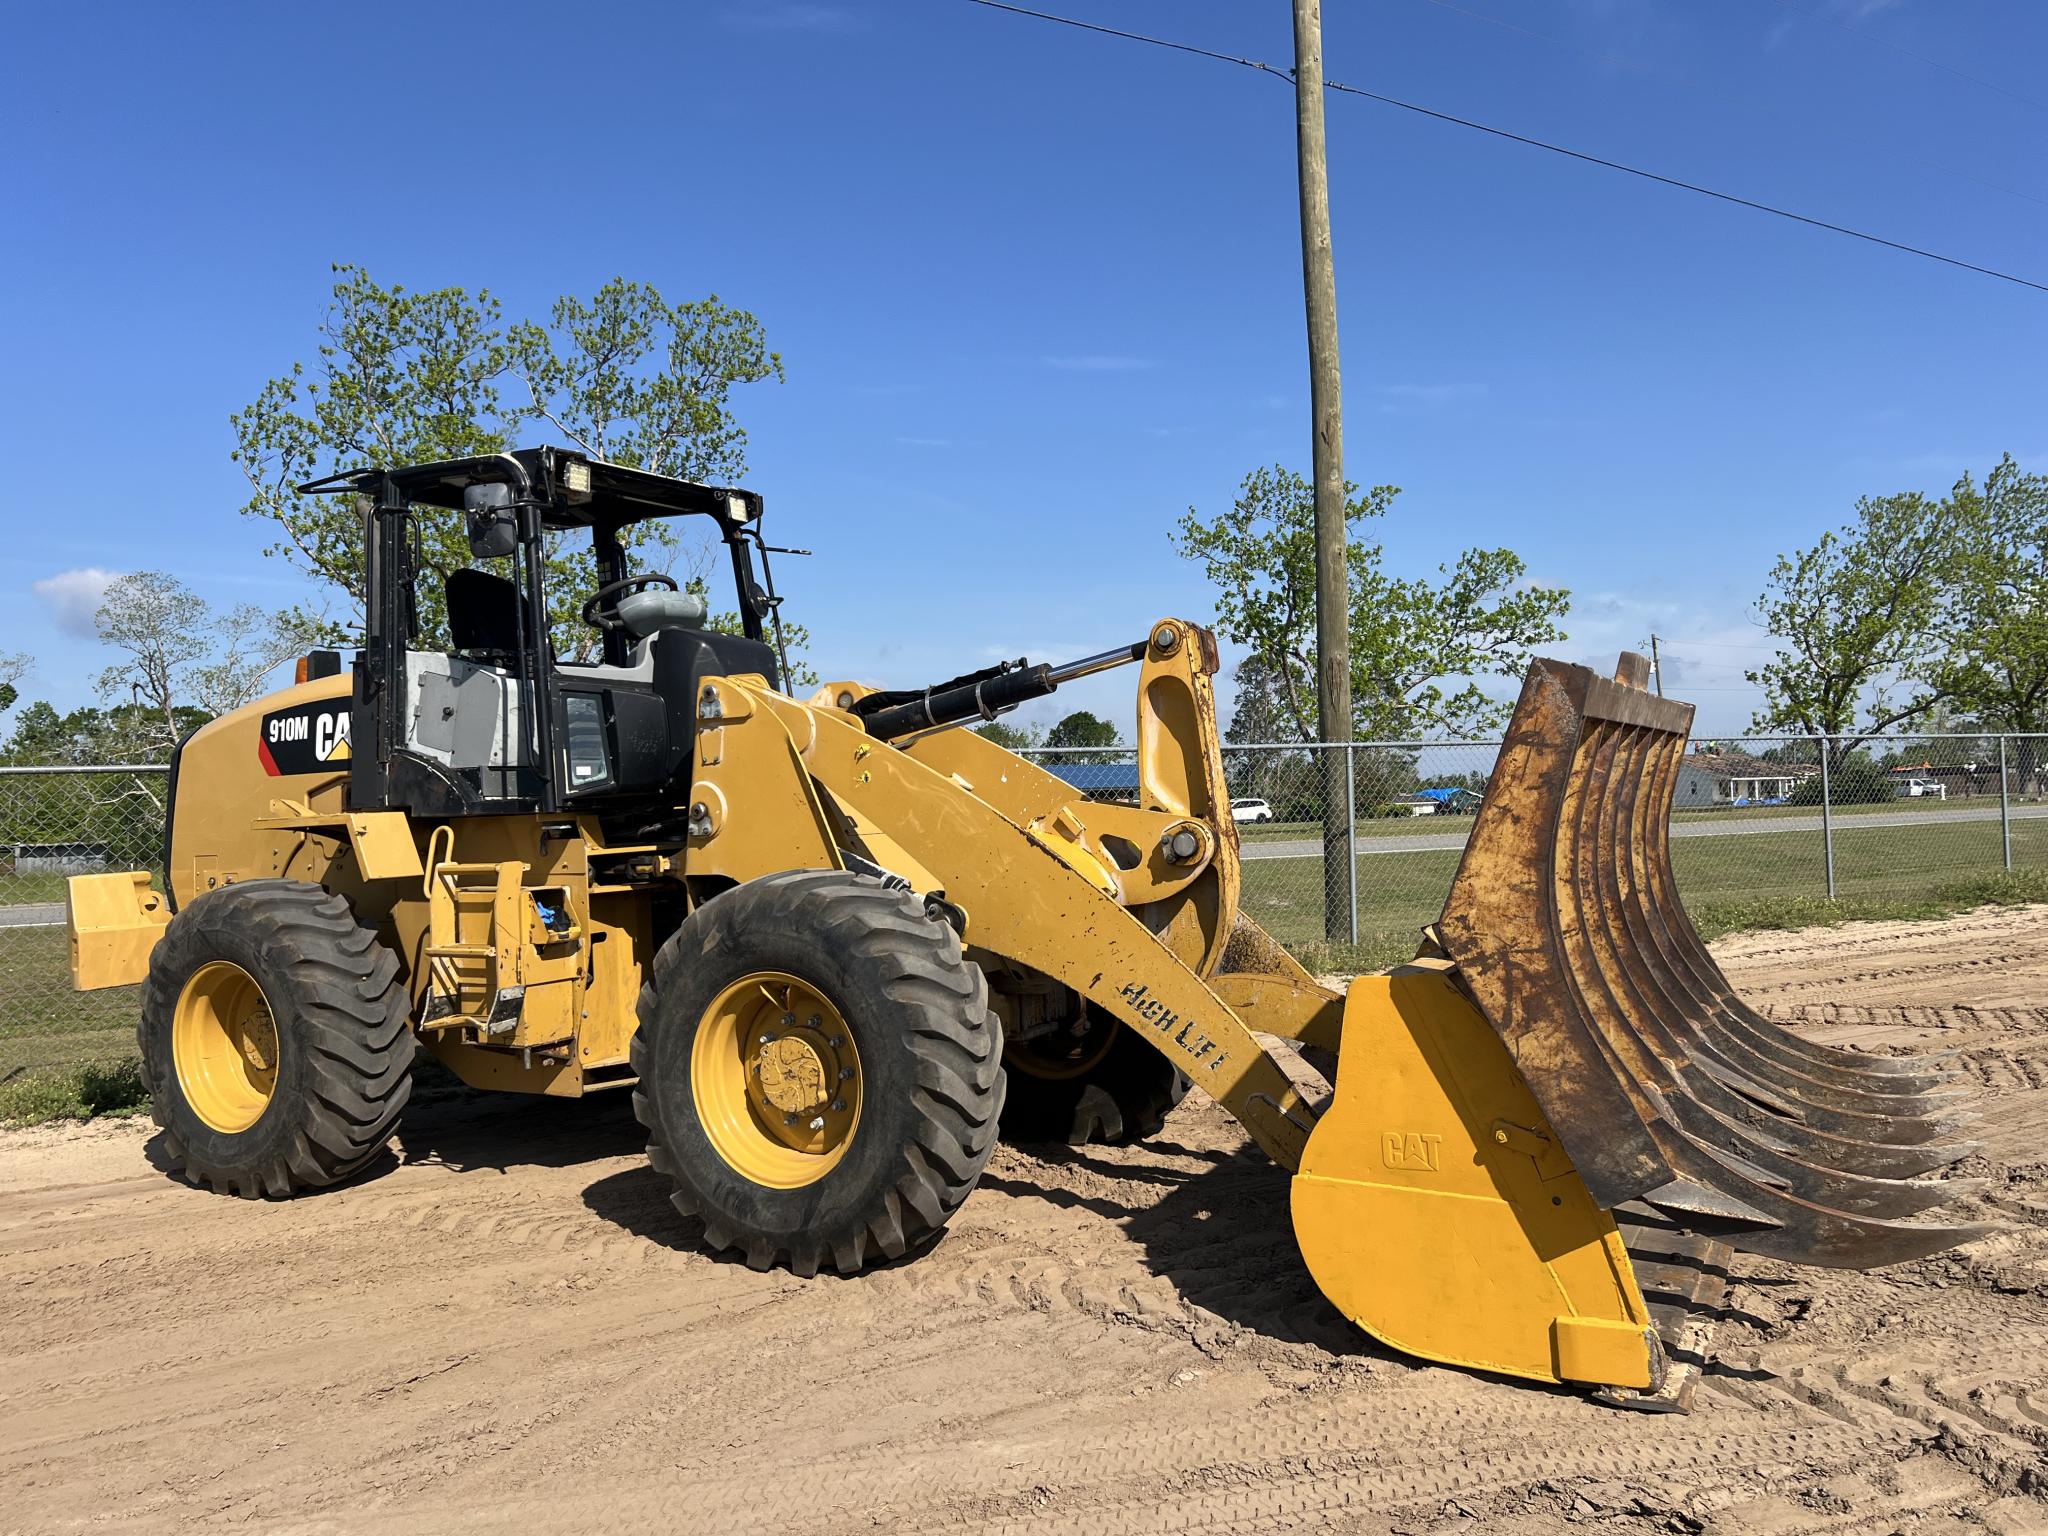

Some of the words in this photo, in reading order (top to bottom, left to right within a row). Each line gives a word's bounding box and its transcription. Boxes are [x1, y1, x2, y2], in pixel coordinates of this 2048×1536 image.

[269, 715, 309, 743] 910M
[315, 711, 353, 762] CA
[1381, 1131, 1442, 1172] CAT
